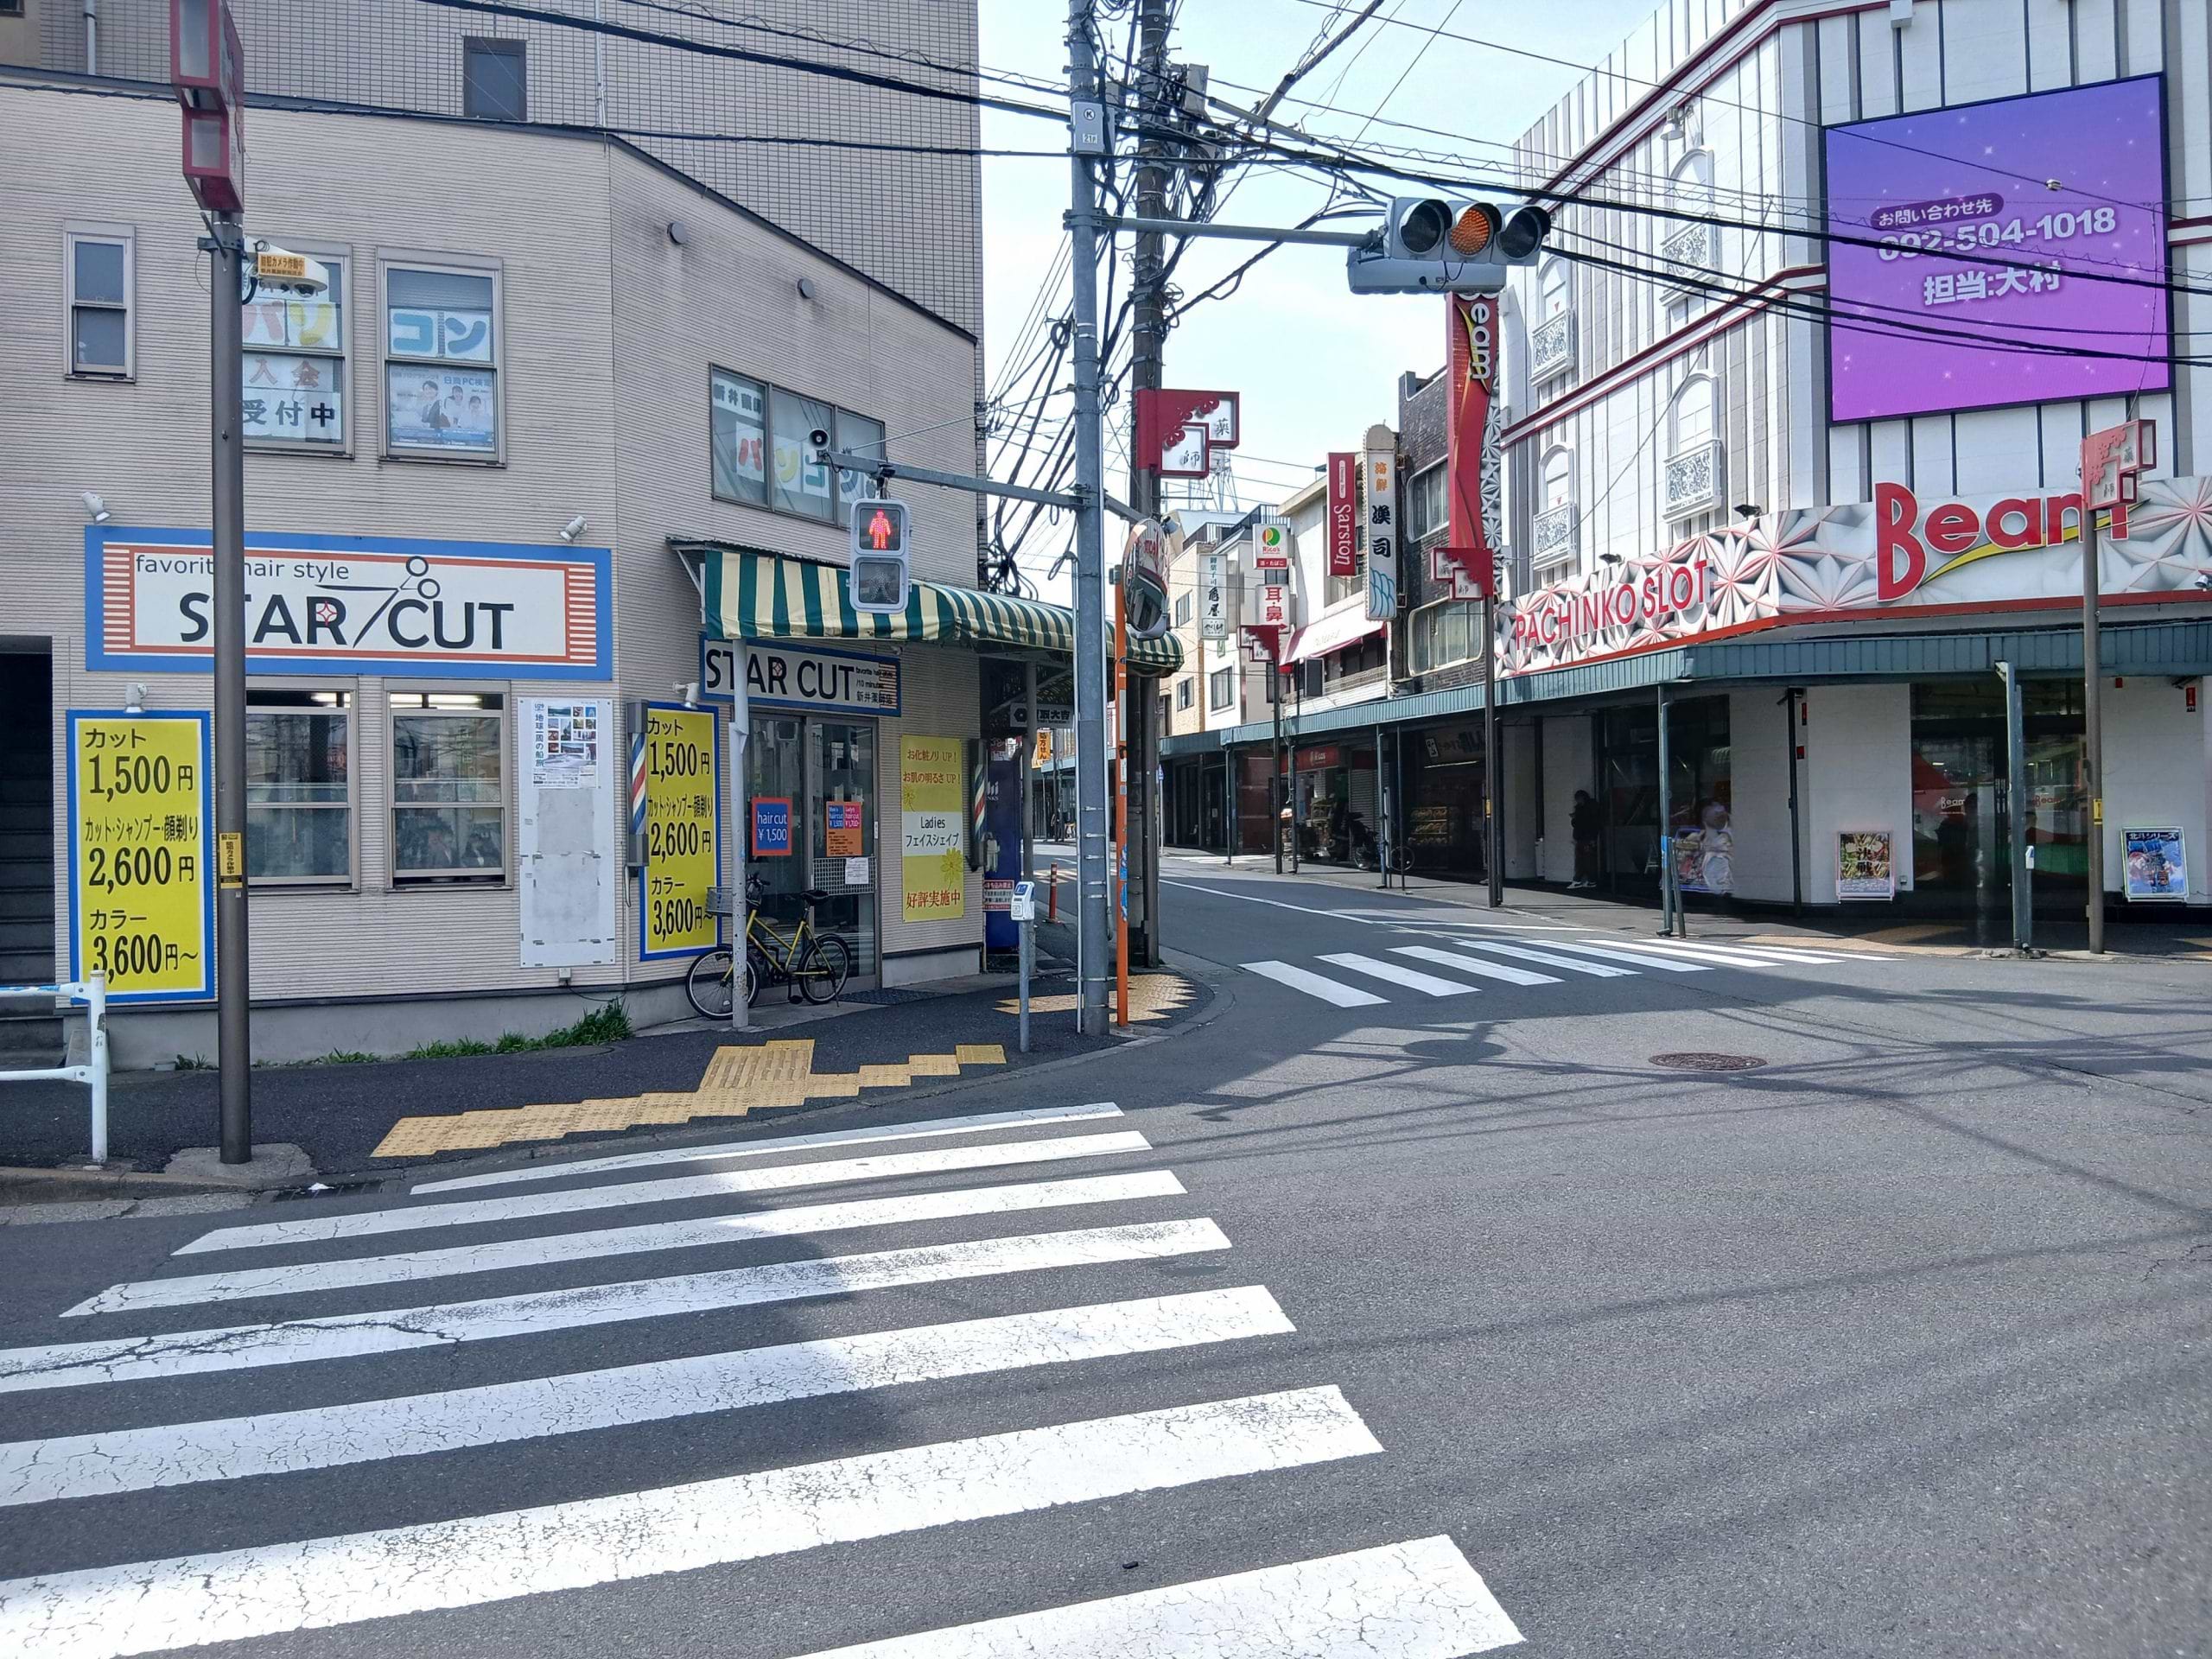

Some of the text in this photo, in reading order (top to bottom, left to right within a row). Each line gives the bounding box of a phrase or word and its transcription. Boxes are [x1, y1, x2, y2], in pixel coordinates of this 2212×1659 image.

[1878, 198, 1993, 227] お問い合わせ先
[249, 358, 321, 388] 入会
[243, 398, 336, 428] 受付中
[1333, 504, 1352, 566] Sarston
[136, 555, 214, 575] favorit
[294, 561, 349, 582] style
[1516, 560, 1709, 650] PACHINKO SLOT
[180, 592, 514, 650] SAR CUT
[797, 659, 855, 701] CUT
[648, 716, 683, 736] カット
[1037, 709, 1071, 721] 取大吉
[85, 728, 147, 749] カット
[920, 816, 946, 829] Ladies
[651, 876, 685, 896] カラー
[906, 888, 961, 910] 好評実施中
[90, 909, 148, 931] カラー
